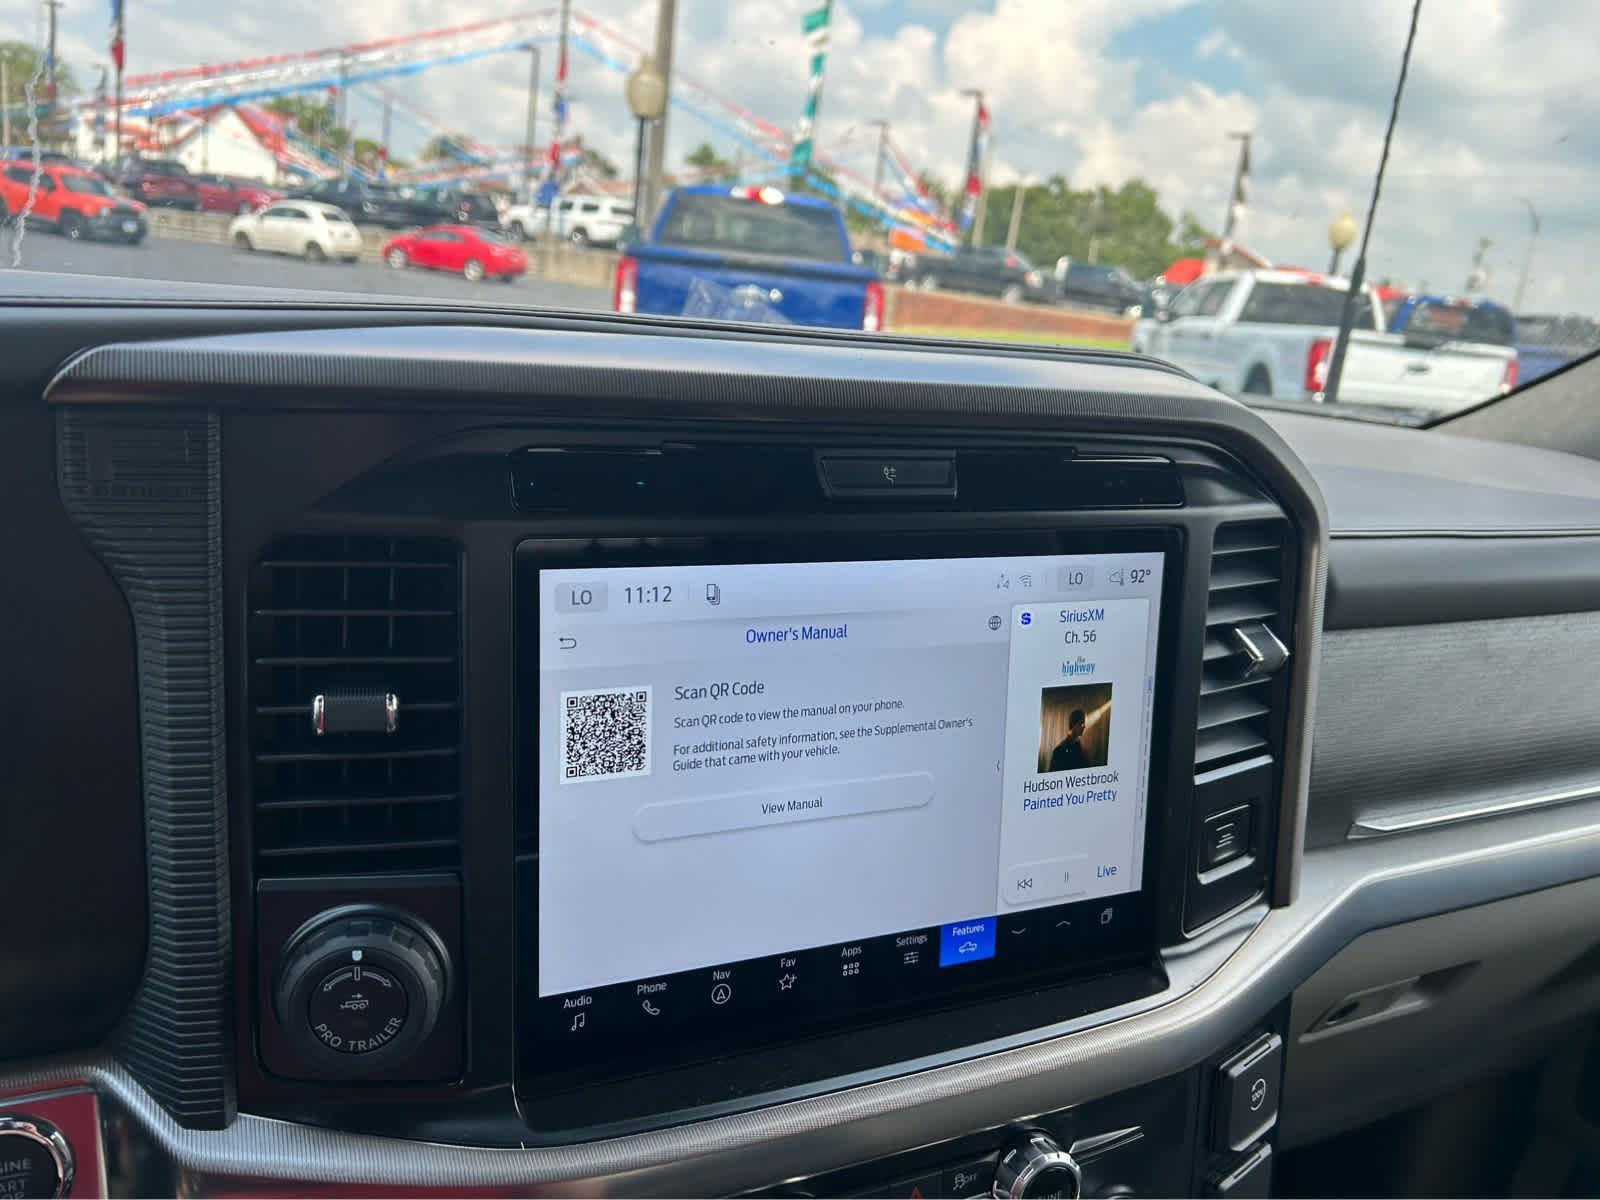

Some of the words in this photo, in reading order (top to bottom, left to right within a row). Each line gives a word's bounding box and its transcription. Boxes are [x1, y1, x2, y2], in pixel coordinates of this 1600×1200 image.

[1069, 572, 1083, 585] LO
[571, 590, 593, 606] LO
[624, 586, 673, 604] 11:12
[1059, 608, 1105, 623] SiriusXM
[746, 627, 799, 644] Owner's
[801, 624, 848, 641] Manual
[1064, 631, 1081, 644] Ch.
[1083, 630, 1097, 643] 56
[674, 686, 707, 701] Scan
[710, 682, 730, 701] QR
[732, 680, 765, 696] Code
[674, 716, 700, 729] Scan
[701, 714, 718, 728] QR
[719, 712, 744, 725] code
[745, 712, 756, 722] to
[758, 710, 781, 721] view
[783, 707, 799, 719] the
[801, 703, 837, 717] manual
[839, 704, 850, 715] on
[852, 703, 872, 715] your
[874, 699, 904, 713] phone.
[674, 744, 689, 756] For
[692, 737, 744, 755] additional
[746, 736, 777, 749] safety
[779, 731, 838, 745] information,
[840, 728, 856, 740] see
[857, 726, 873, 738] the
[874, 720, 937, 737] Supplemental
[938, 717, 973, 730] Owner's
[673, 758, 703, 772] Guide
[705, 755, 726, 769] that
[728, 754, 756, 766] came
[758, 750, 780, 762] with
[782, 750, 803, 763] your
[805, 744, 840, 758] vehicle.
[1023, 778, 1063, 794] Hudson
[1066, 771, 1119, 788] Westbrook
[761, 803, 785, 815] View
[787, 797, 823, 812] Manual
[1023, 794, 1063, 811] Painted
[1066, 793, 1085, 805] You
[1086, 789, 1118, 803] Pretty
[1097, 865, 1118, 878] Live
[952, 923, 985, 937] Features
[896, 933, 928, 948] Settings
[841, 945, 862, 959] Apps
[780, 957, 797, 968] Fav
[713, 970, 731, 981] Nav
[637, 981, 668, 996] Phone
[563, 995, 593, 1009] Audio
[315, 1023, 342, 1048] PRO
[348, 1016, 402, 1051] TRAILER
